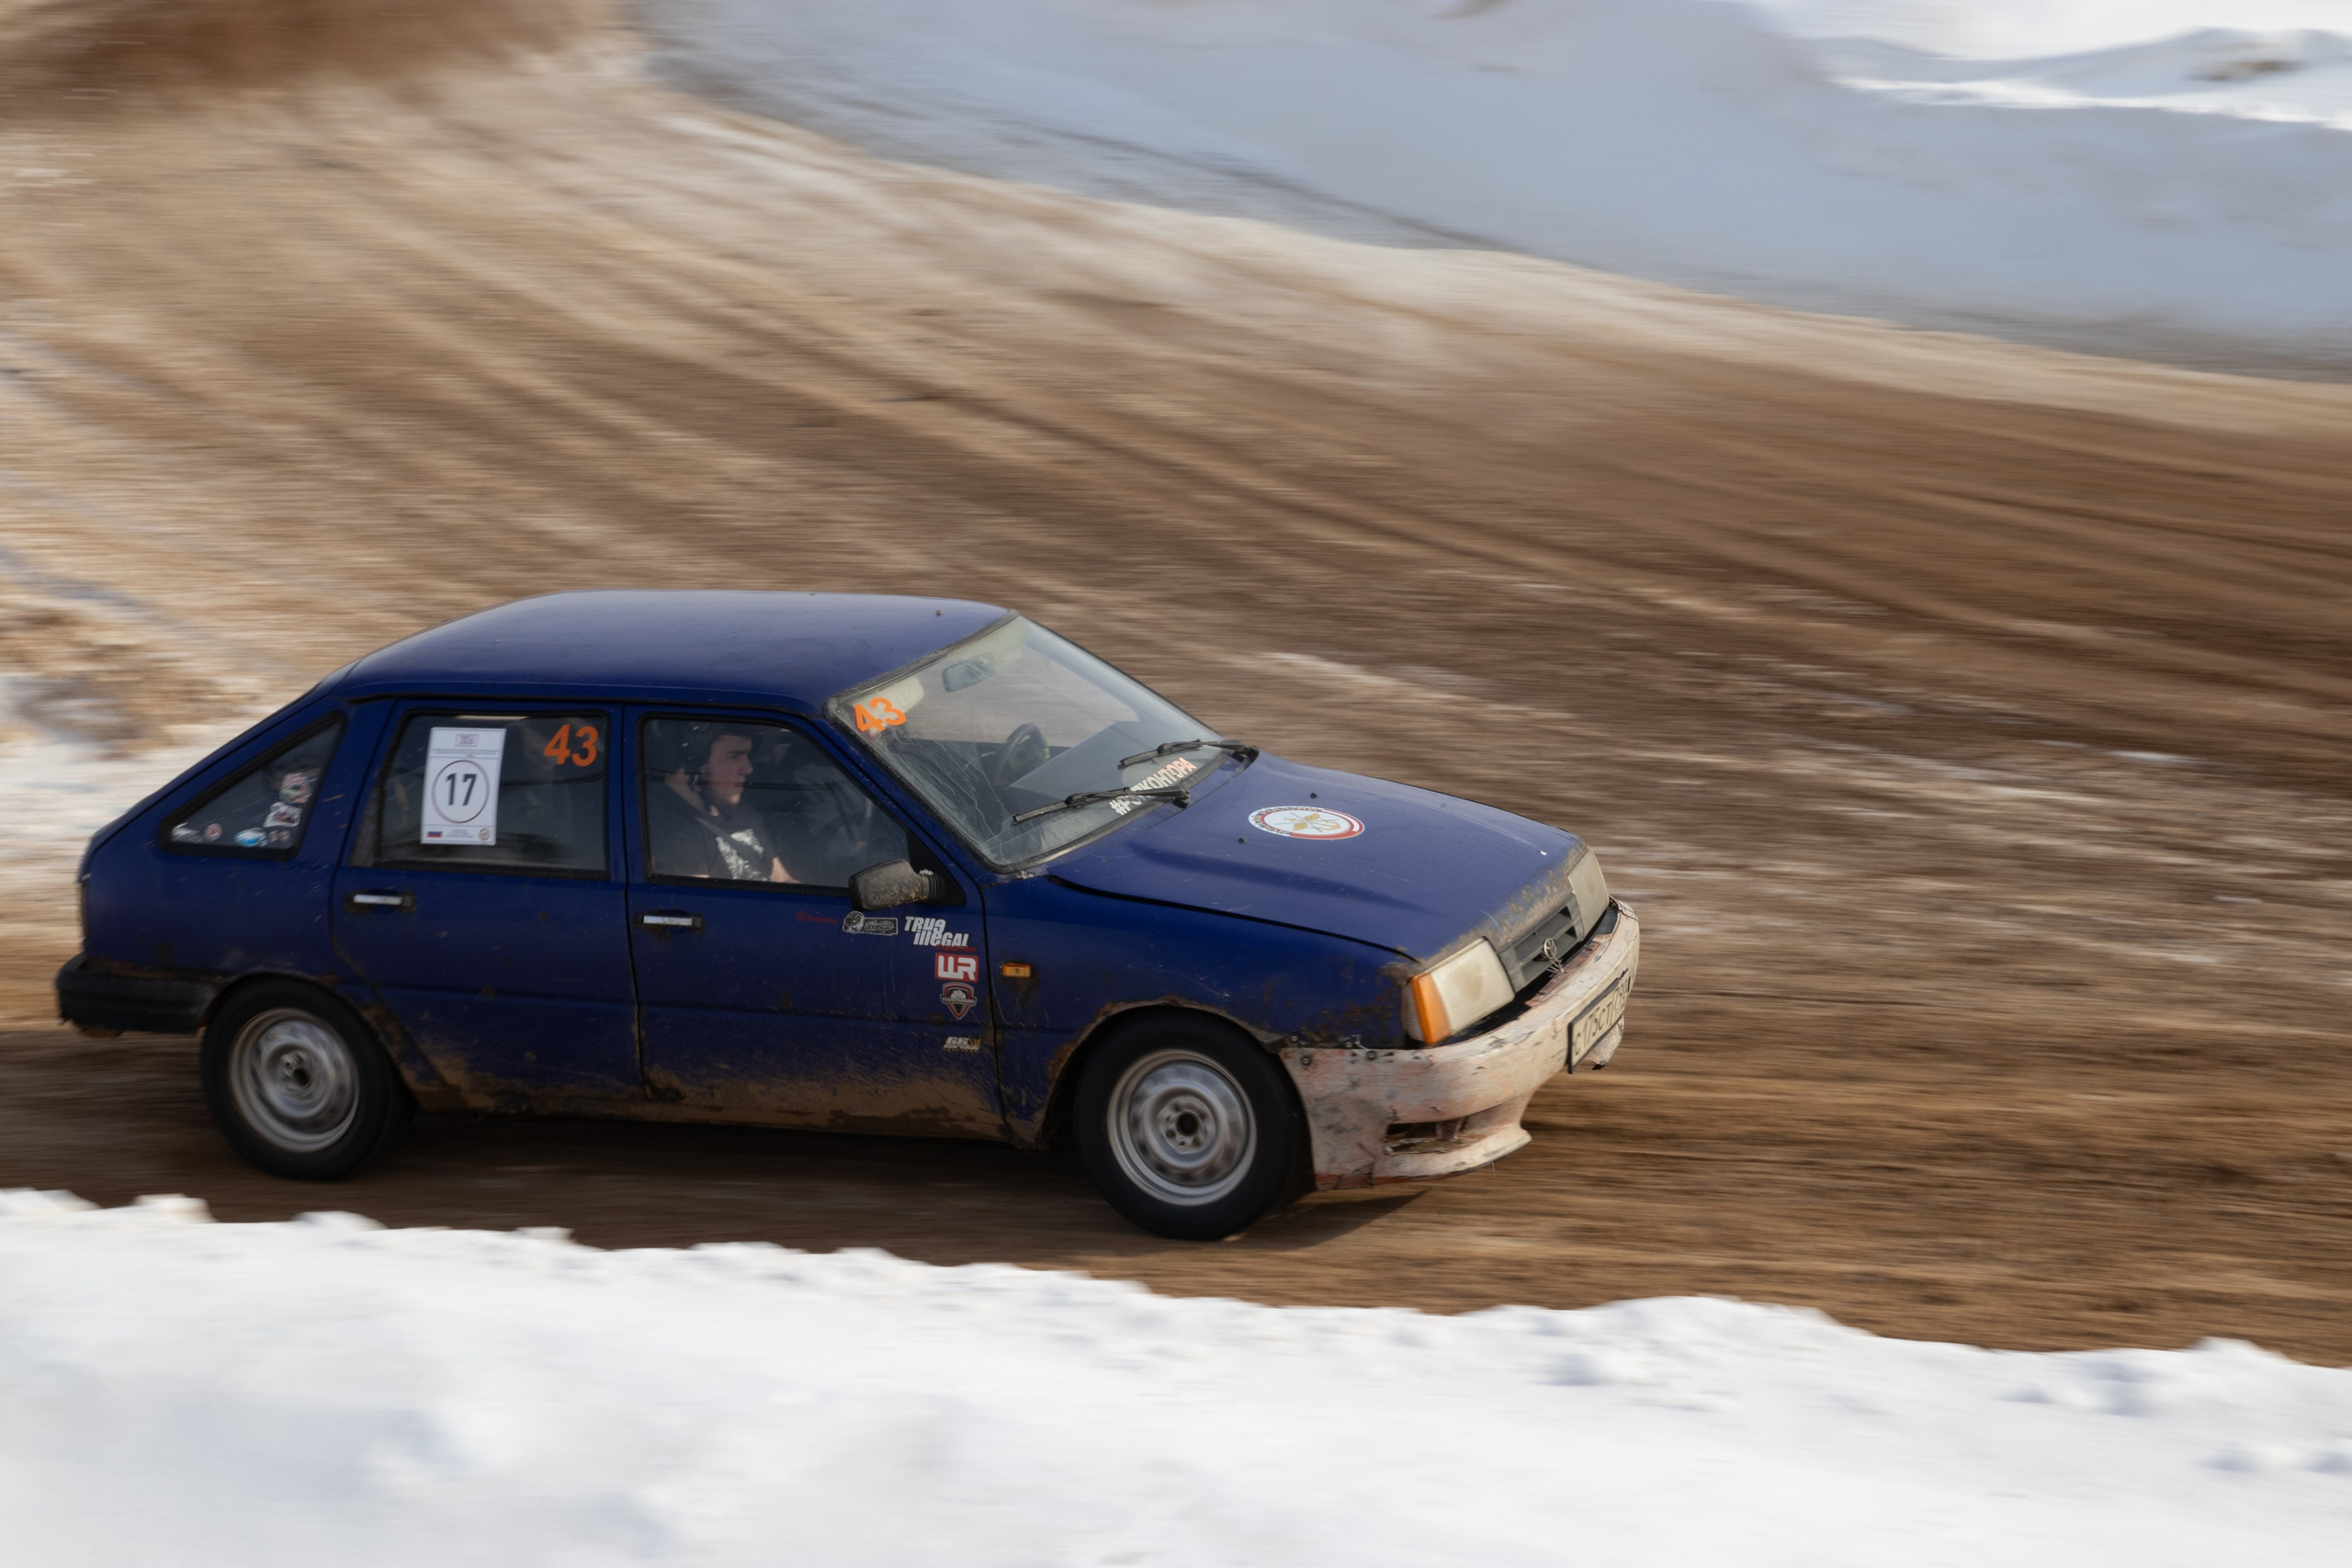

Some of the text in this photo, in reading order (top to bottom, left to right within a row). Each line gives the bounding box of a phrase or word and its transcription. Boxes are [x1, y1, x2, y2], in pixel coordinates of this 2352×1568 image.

[854, 696, 906, 732] 43
[544, 724, 598, 767] 43
[446, 773, 477, 807] 17
[937, 954, 977, 981] WR
